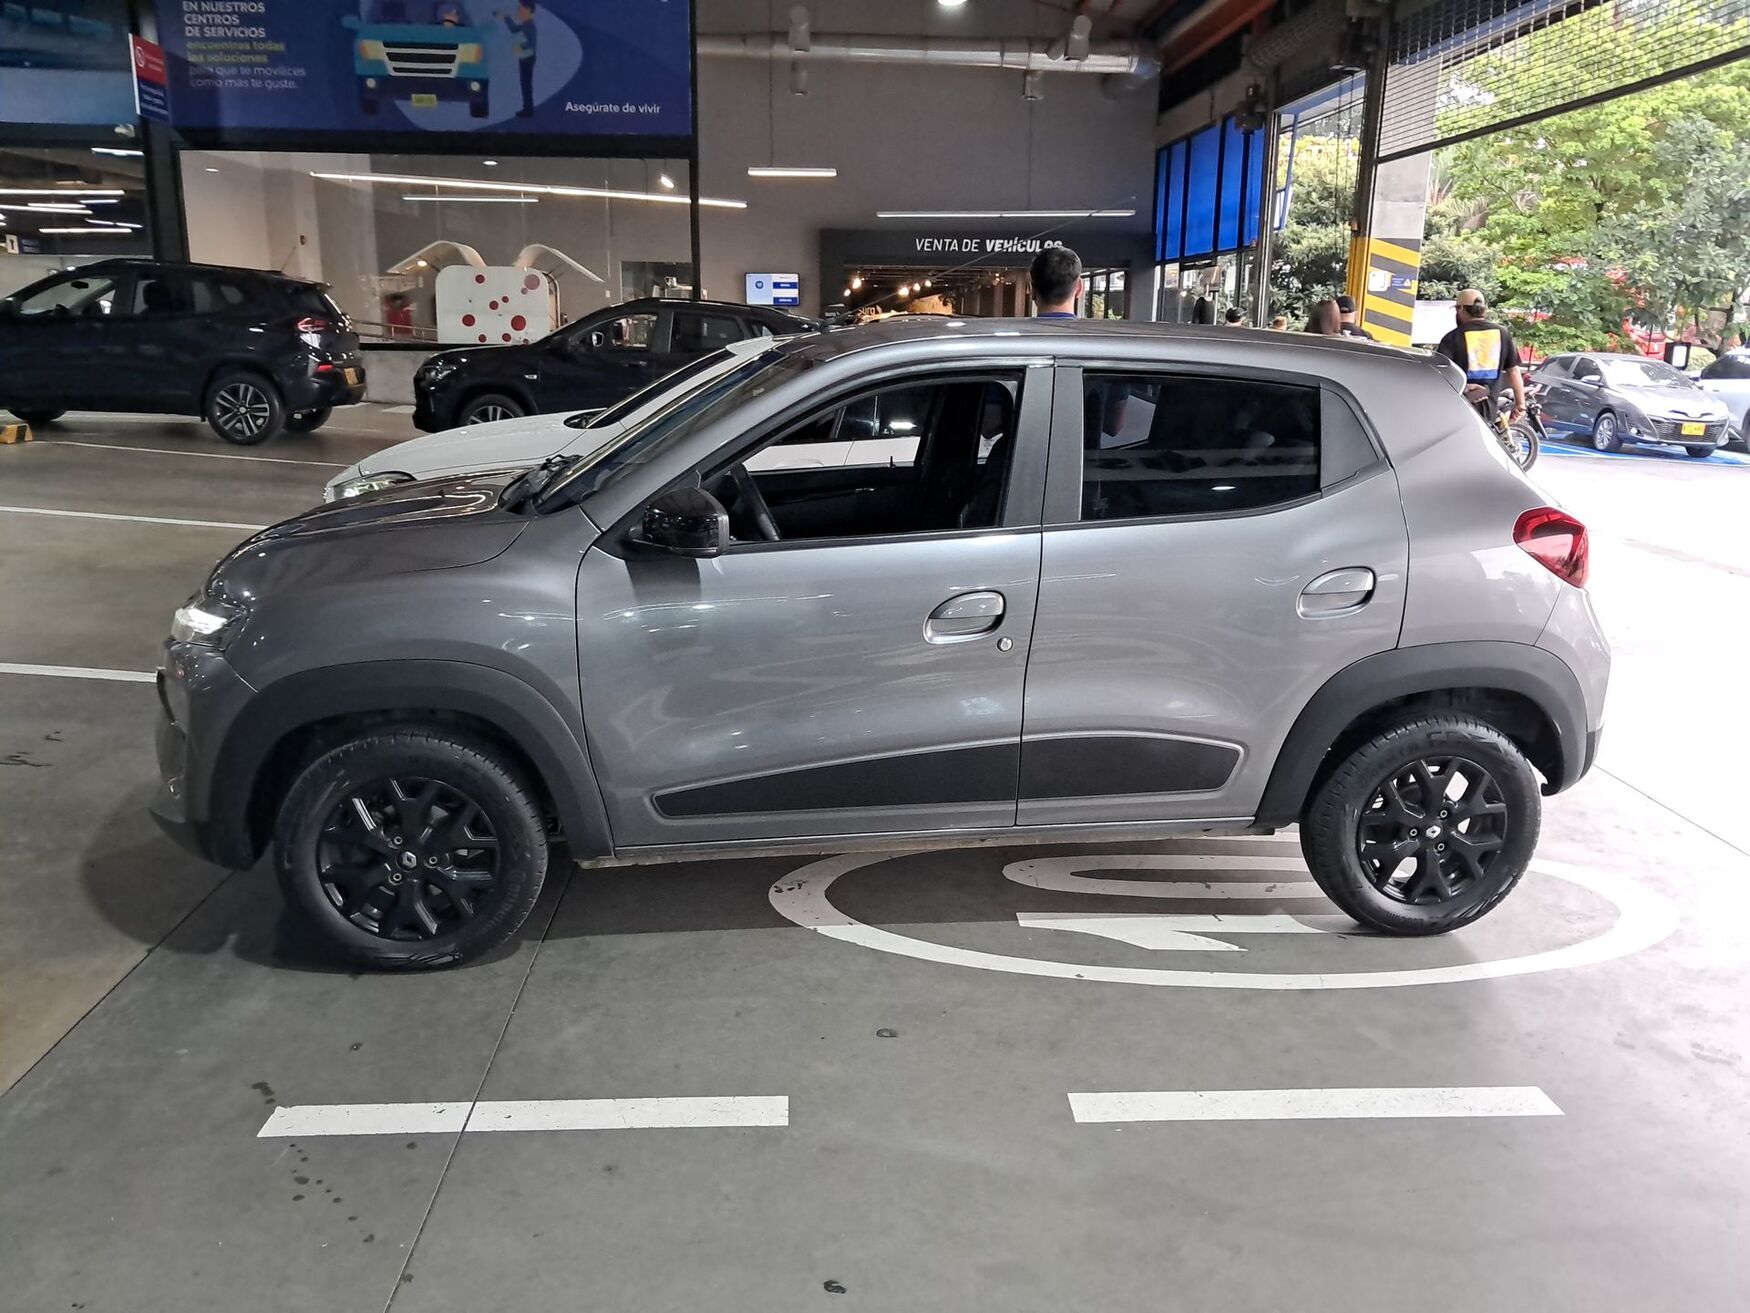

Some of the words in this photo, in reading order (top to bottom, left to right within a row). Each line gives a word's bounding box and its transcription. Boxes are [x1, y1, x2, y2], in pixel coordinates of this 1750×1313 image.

[183, 1, 199, 12] EN
[201, 1, 266, 13] NUESTROS
[184, 13, 240, 25] CENTROS
[185, 26, 201, 37] DE
[203, 27, 266, 38] SERVICIOS
[215, 67, 239, 76] que
[240, 66, 252, 76] te
[254, 66, 307, 77] movilices
[251, 78, 263, 88] te
[265, 79, 298, 90] guste.
[565, 101, 620, 114] Asegúrate
[622, 102, 637, 113] de
[638, 103, 661, 114] vivir
[915, 238, 959, 252] VENTA
[962, 239, 981, 252] DE
